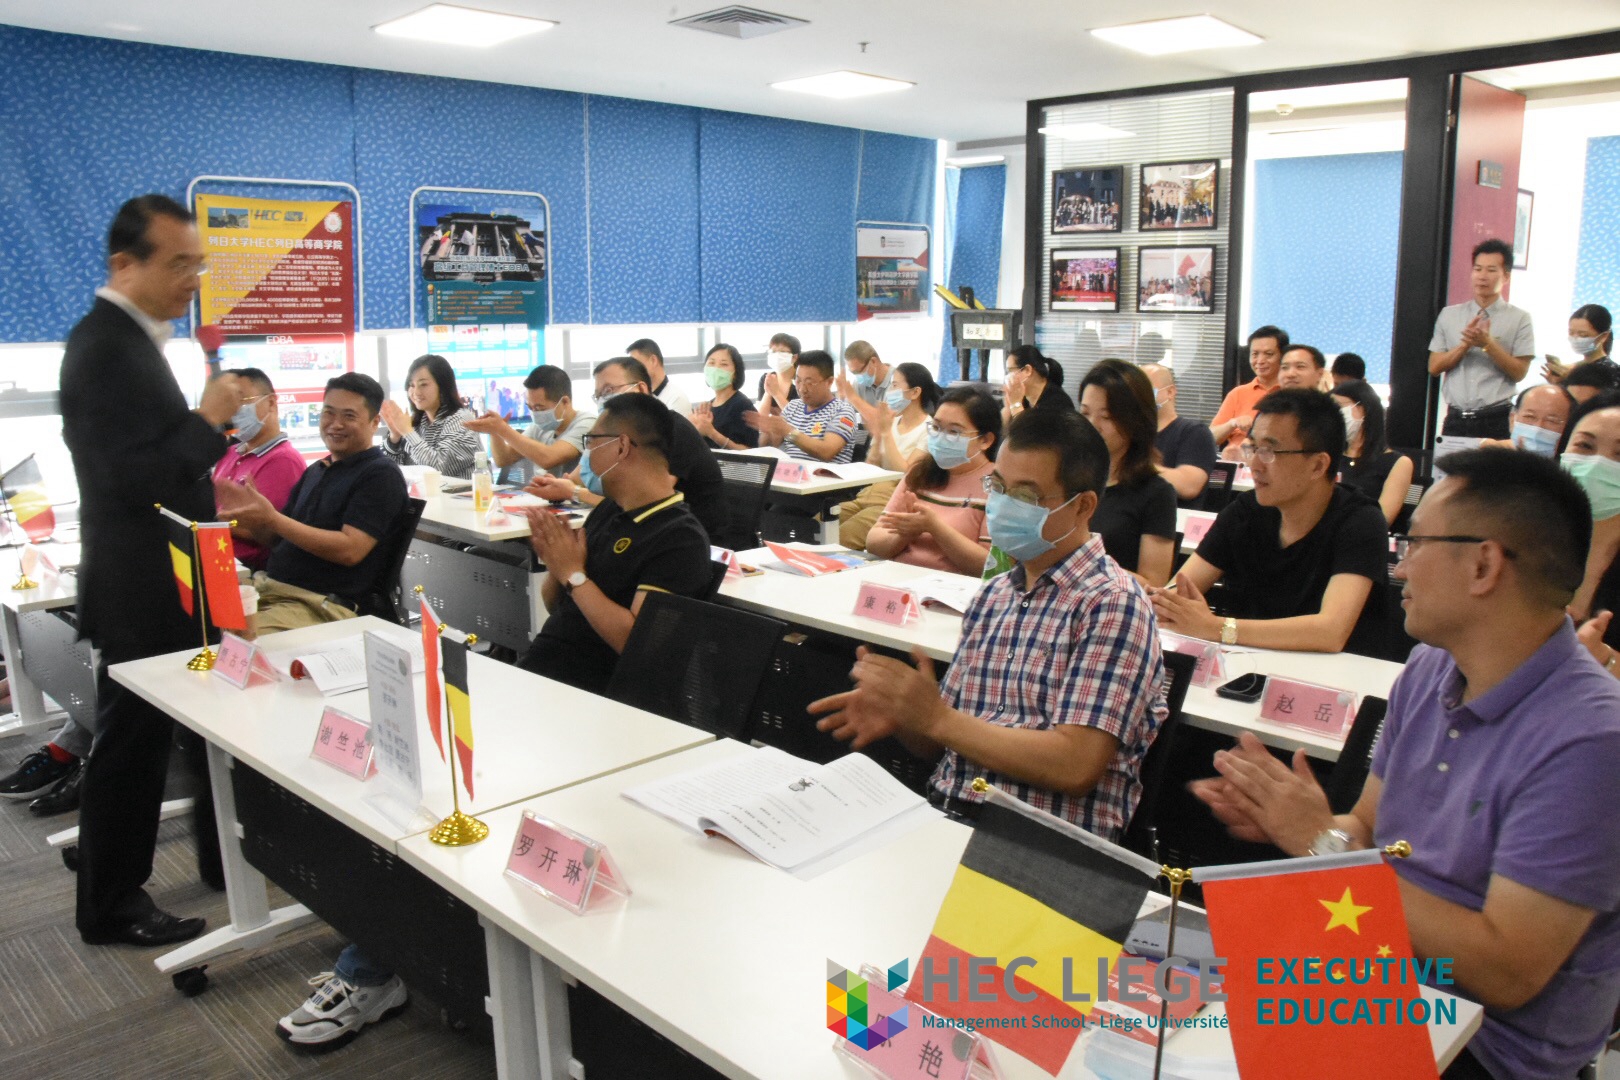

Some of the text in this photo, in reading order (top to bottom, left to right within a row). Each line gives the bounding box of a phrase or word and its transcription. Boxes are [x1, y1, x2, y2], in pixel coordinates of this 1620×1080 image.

[266, 335, 294, 345] EDBA
[1274, 693, 1333, 723] 赵岳
[515, 834, 582, 886] 罗开琳
